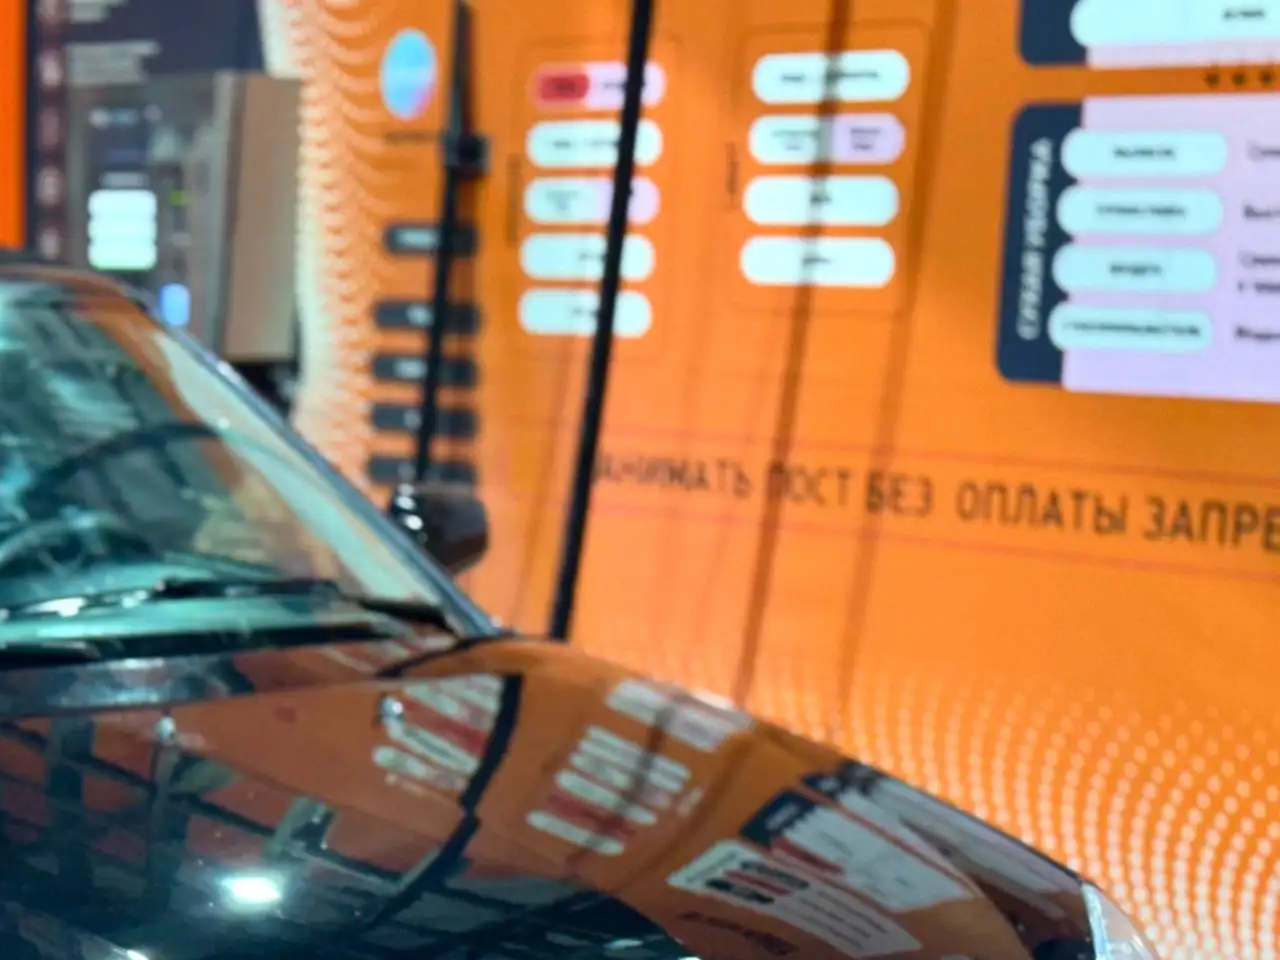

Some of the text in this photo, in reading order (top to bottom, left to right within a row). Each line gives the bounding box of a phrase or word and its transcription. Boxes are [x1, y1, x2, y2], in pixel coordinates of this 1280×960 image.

[591, 456, 754, 498] АНИМАТЬ
[866, 469, 933, 518] БЕЗ
[954, 479, 1129, 536] ОПЛАТЫ
